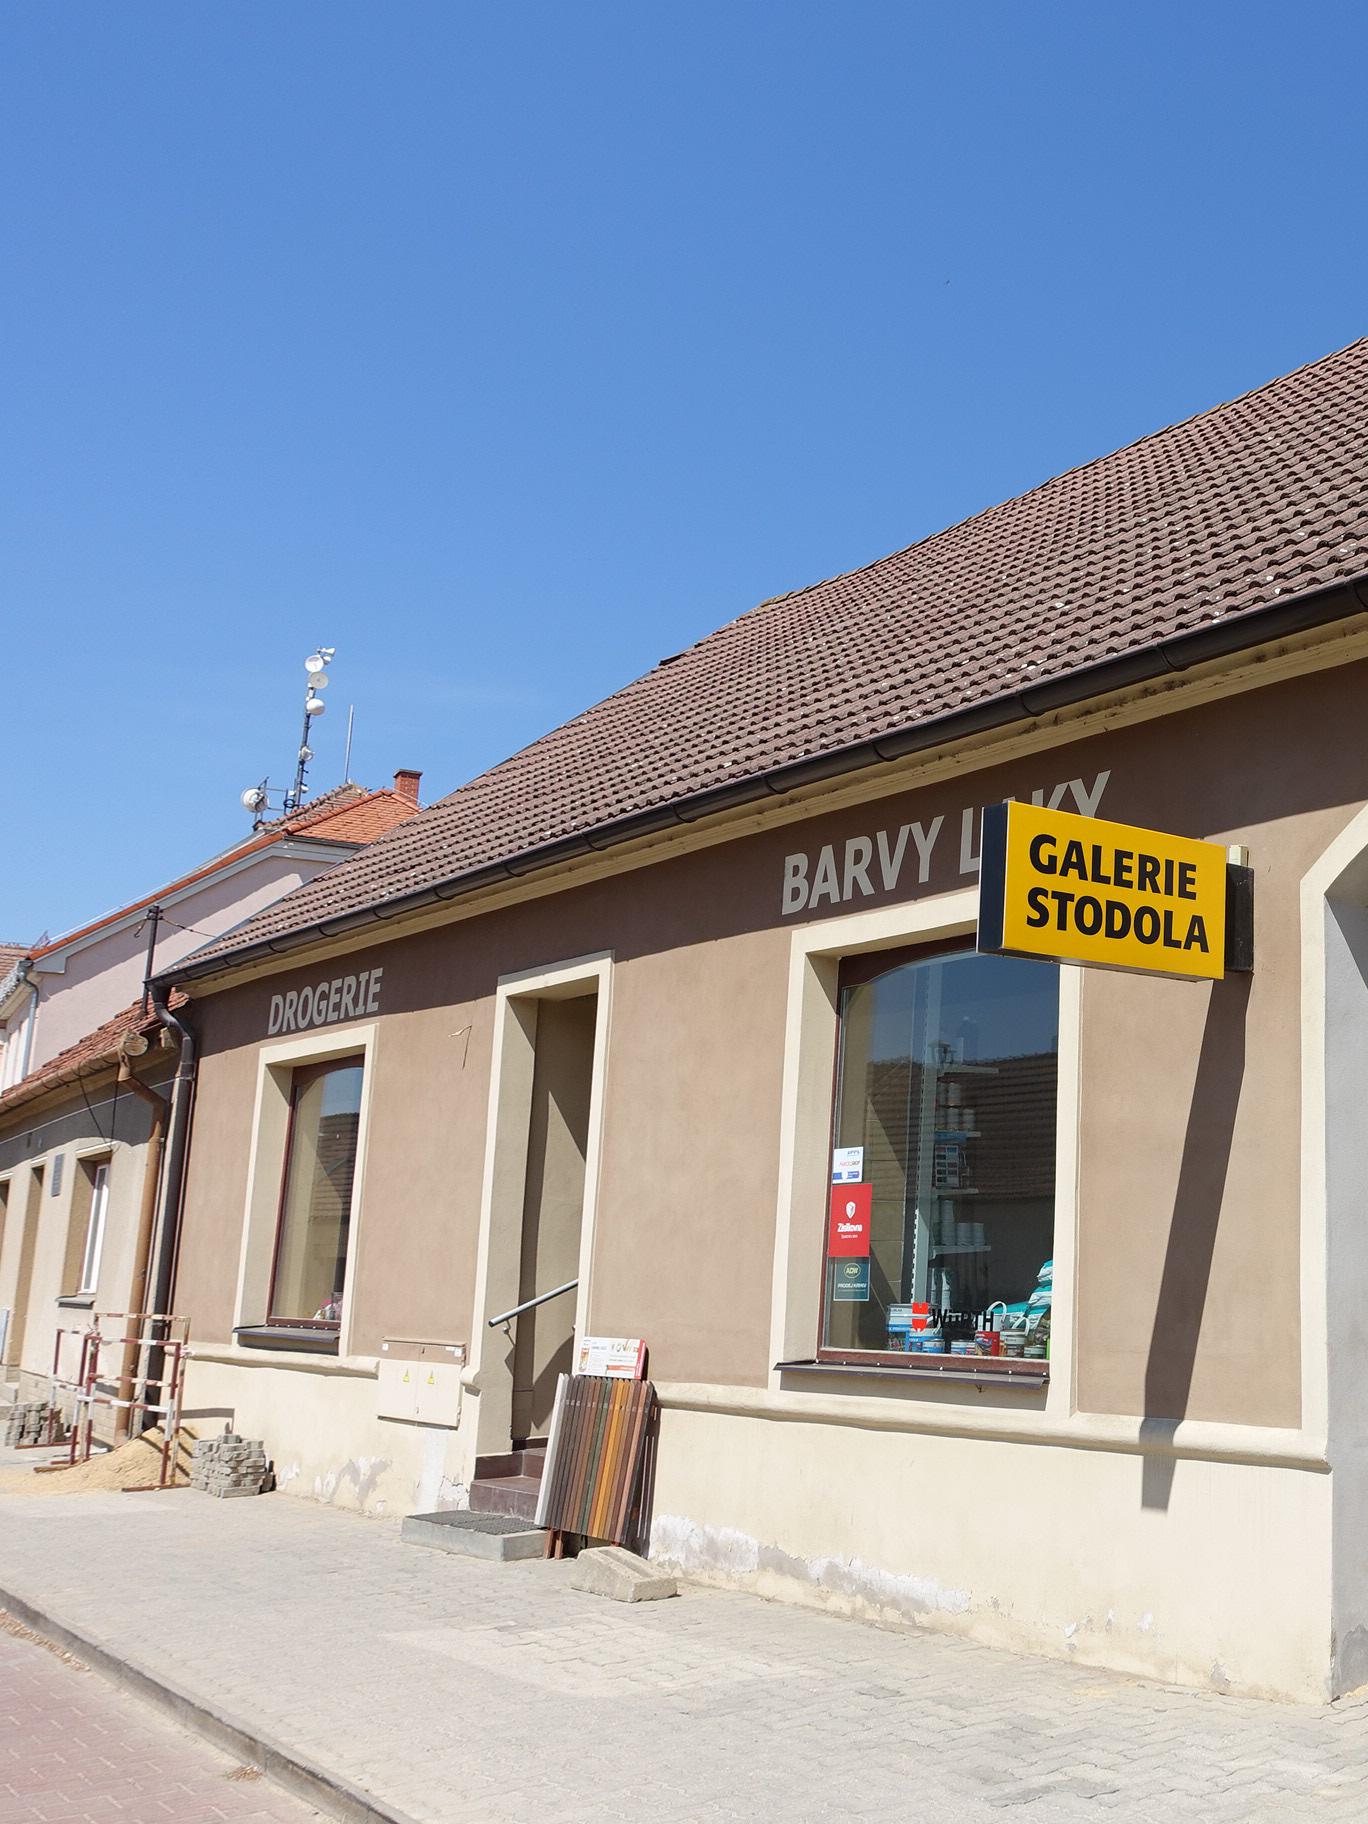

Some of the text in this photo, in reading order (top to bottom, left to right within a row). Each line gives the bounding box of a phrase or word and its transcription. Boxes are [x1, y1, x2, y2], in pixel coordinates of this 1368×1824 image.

[781, 769, 1112, 916] BARVY LY
[1029, 833, 1198, 901] GALERIE
[1026, 886, 1210, 953] STODOLA
[268, 967, 383, 1035] DROGERIE
